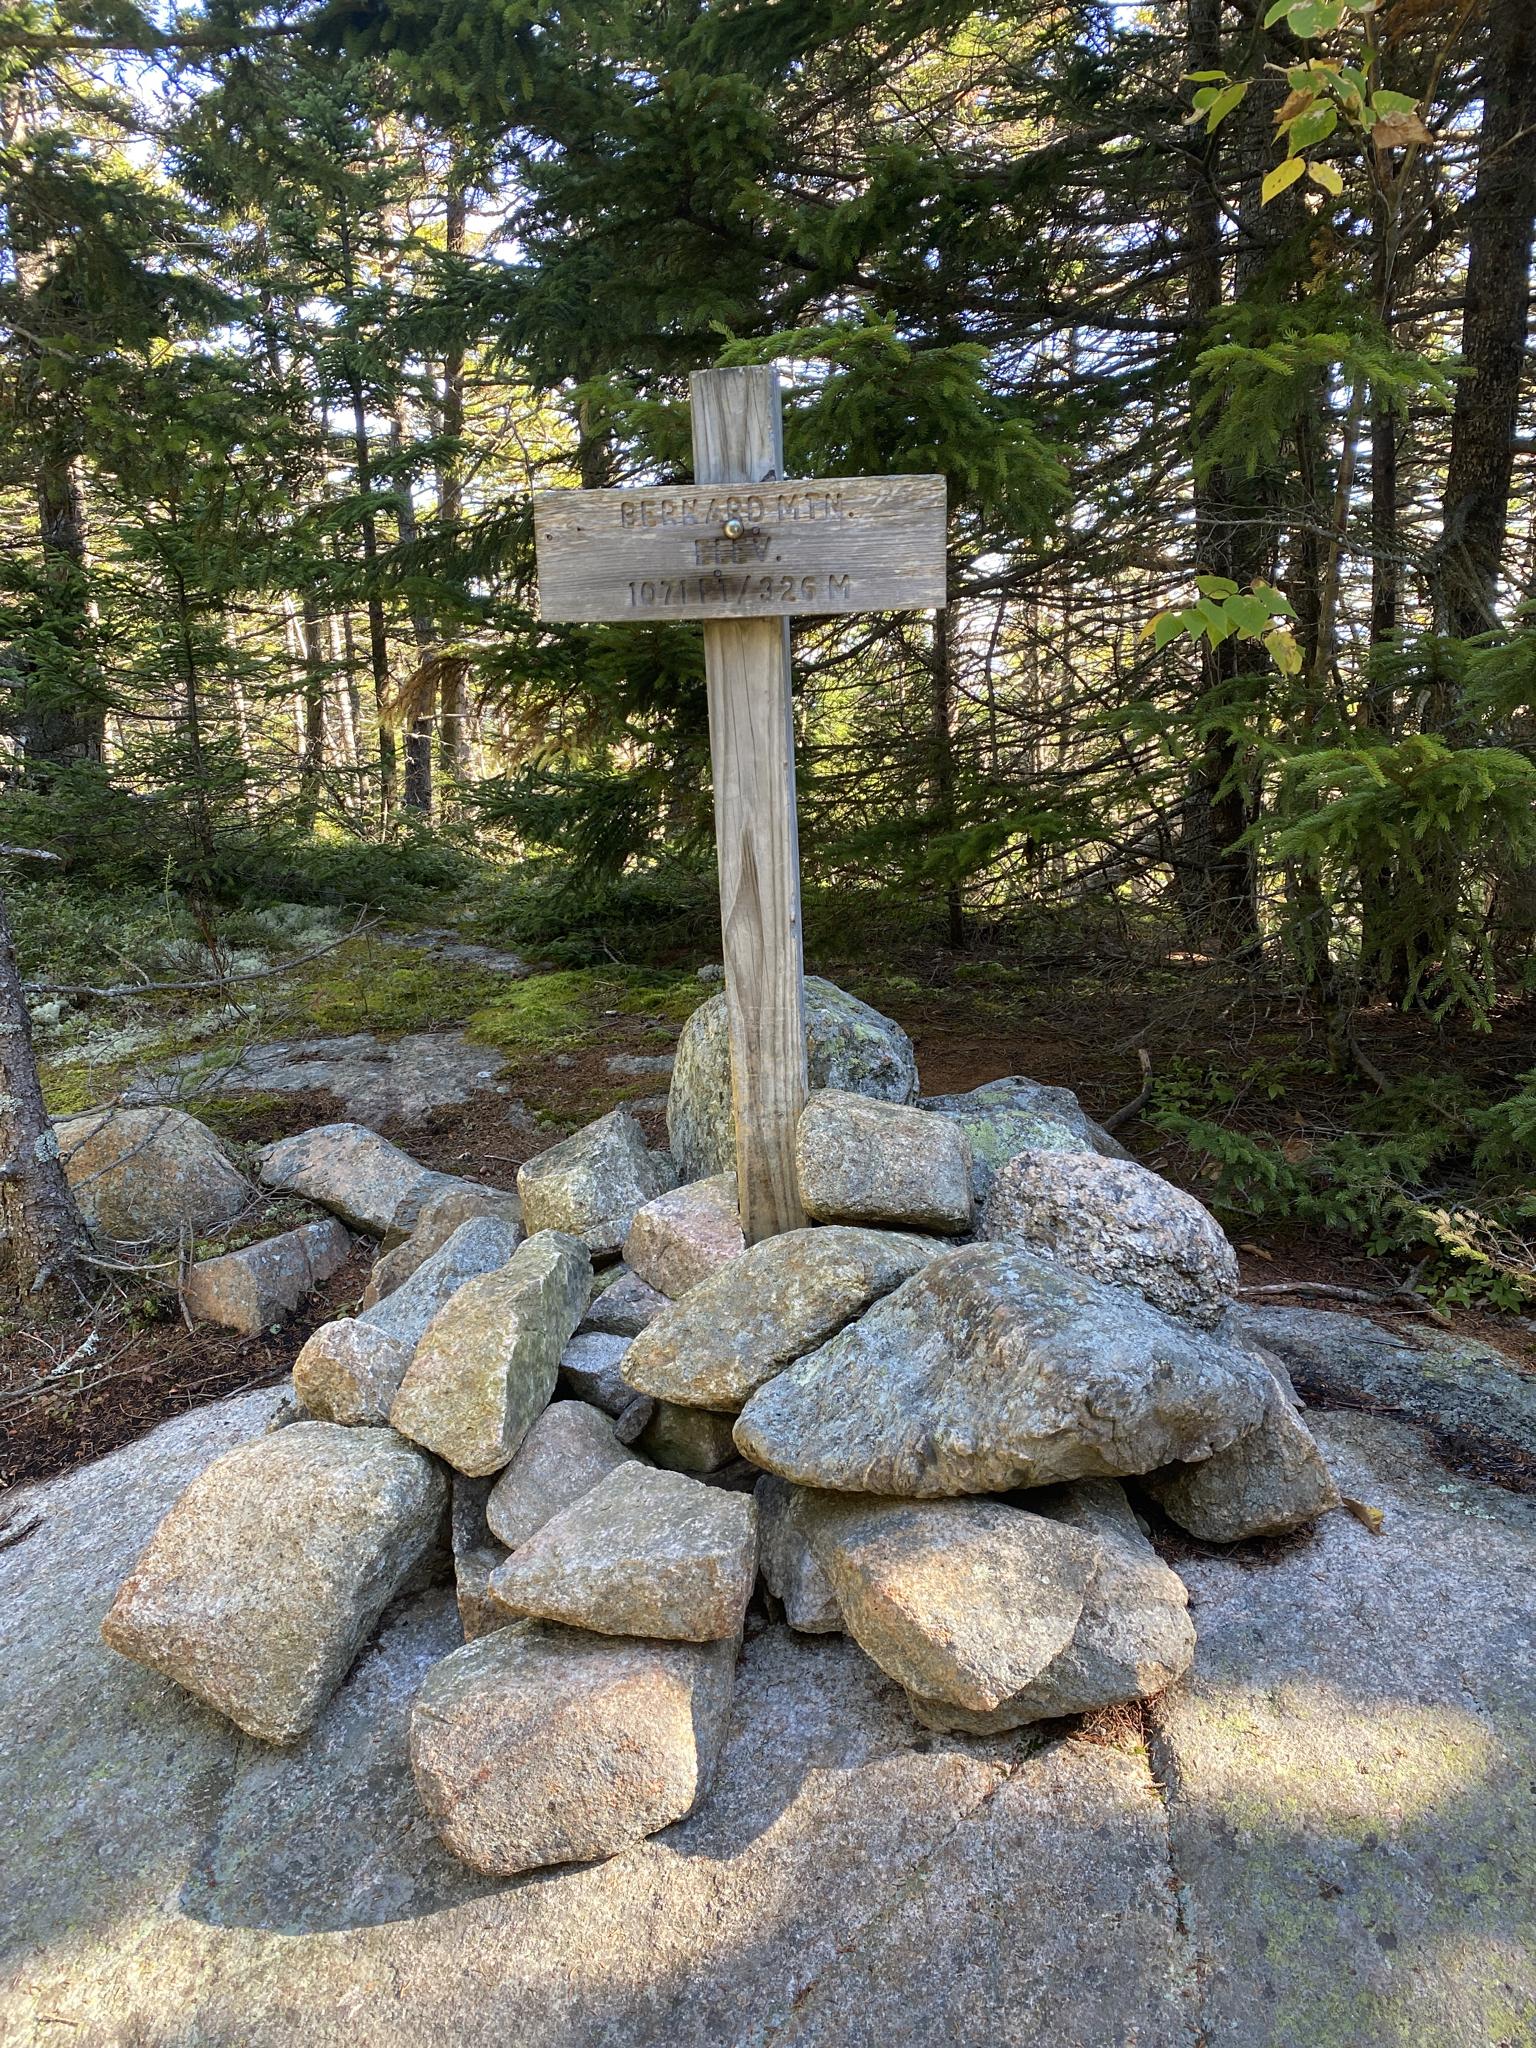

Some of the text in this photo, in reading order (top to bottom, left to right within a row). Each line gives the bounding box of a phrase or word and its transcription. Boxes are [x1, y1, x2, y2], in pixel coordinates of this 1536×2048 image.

[620, 495, 765, 528] BERNARD
[694, 535, 783, 566] ELEV.
[628, 579, 687, 608] 1071
